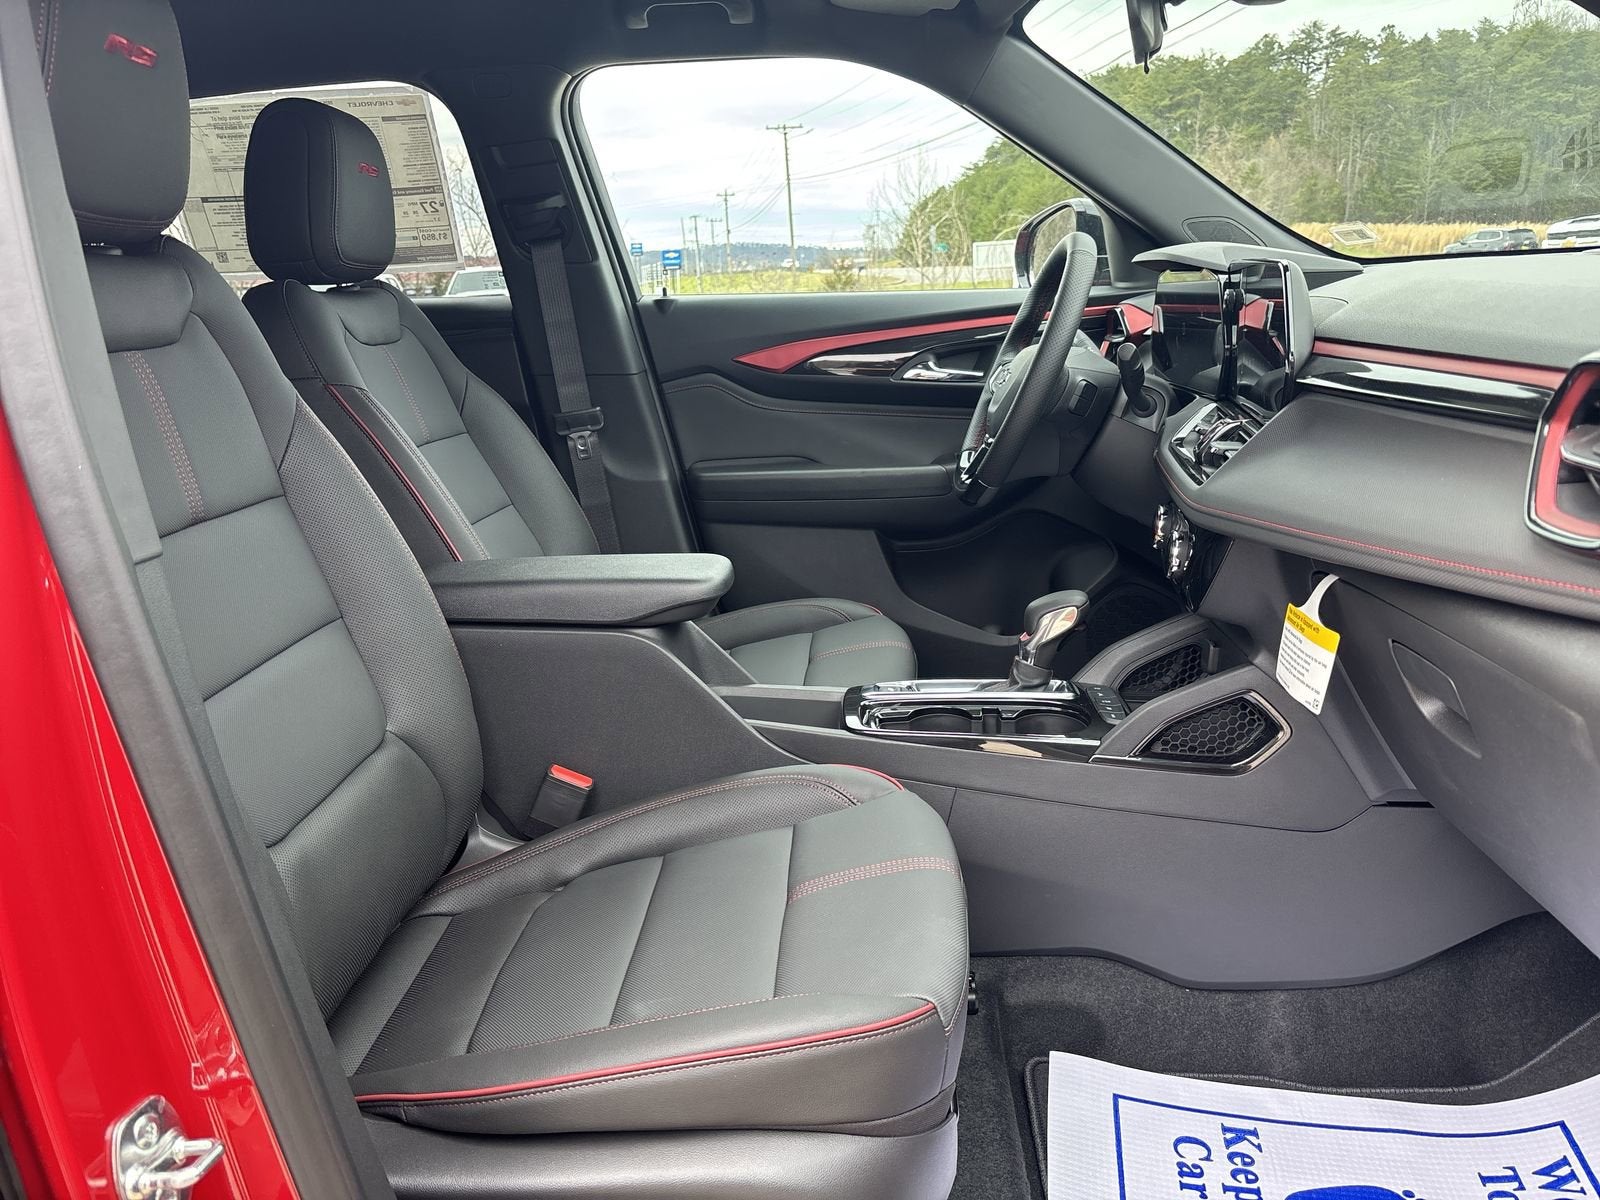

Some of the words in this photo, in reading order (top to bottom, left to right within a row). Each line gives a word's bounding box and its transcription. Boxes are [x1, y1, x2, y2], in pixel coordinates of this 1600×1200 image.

[104, 33, 158, 68] RS
[358, 162, 379, 177] RS
[1173, 1135, 1214, 1200] Car
[1221, 1122, 1263, 1200] Keep
